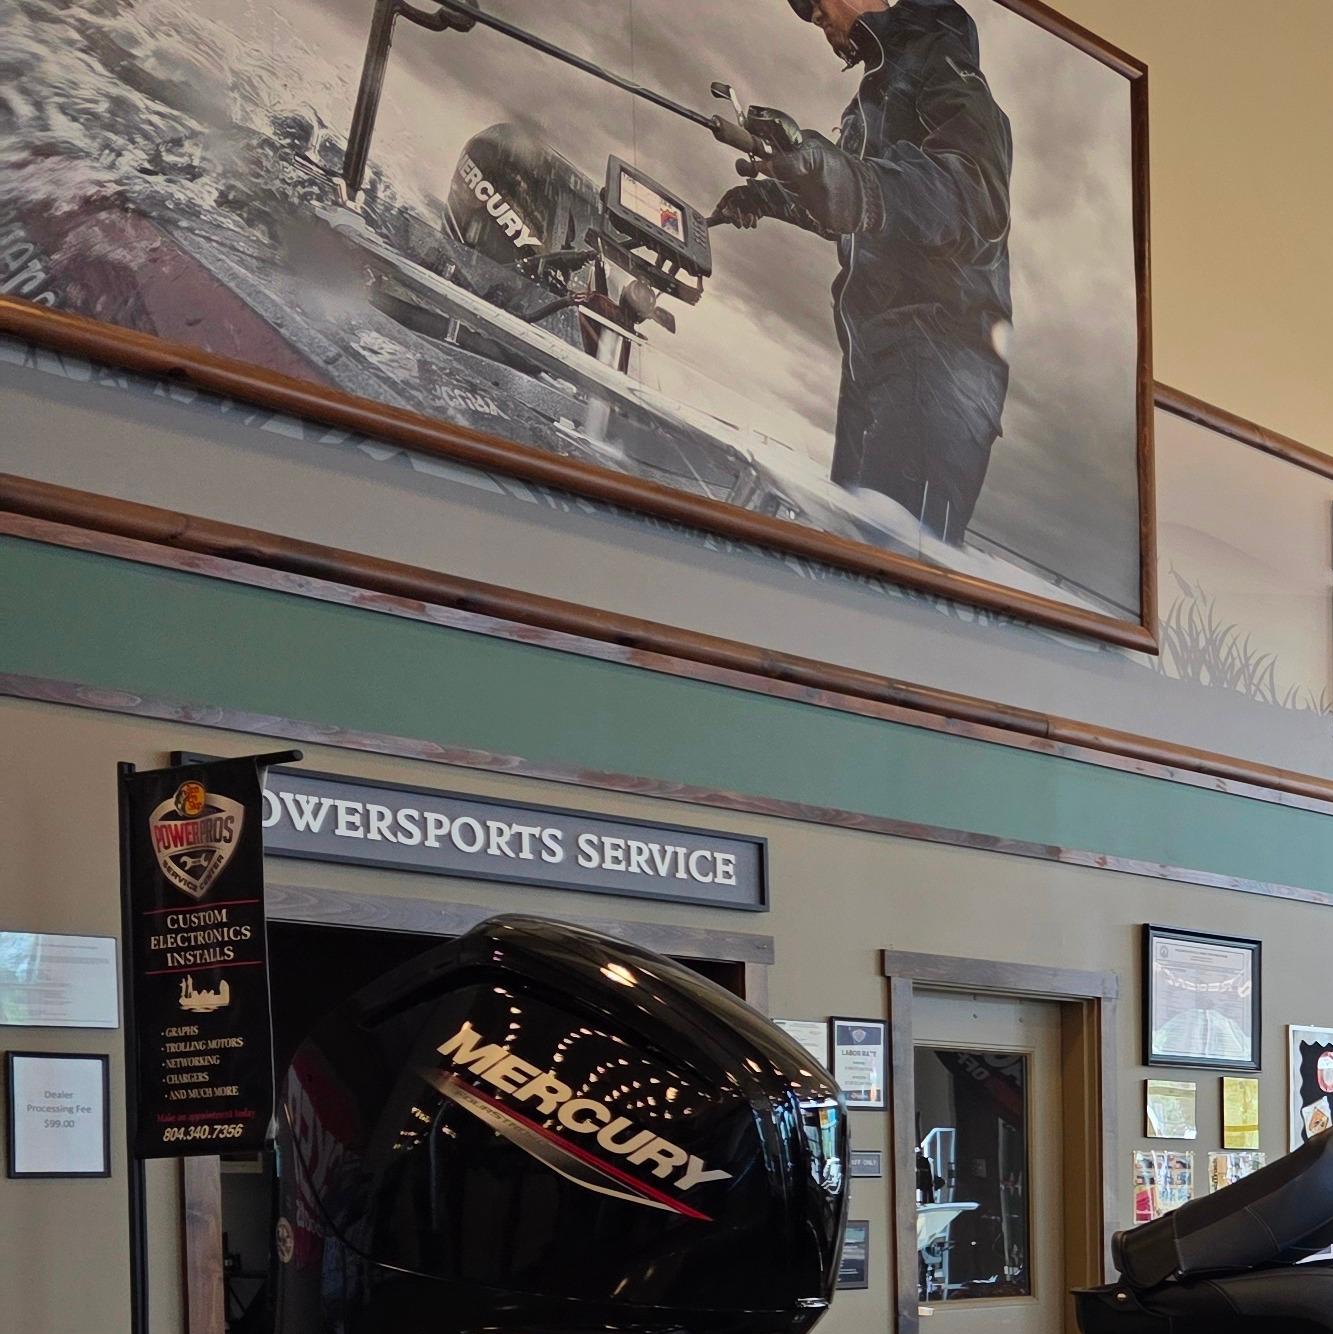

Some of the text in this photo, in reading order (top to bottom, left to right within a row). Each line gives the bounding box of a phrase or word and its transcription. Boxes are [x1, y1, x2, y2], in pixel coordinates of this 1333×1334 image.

[577, 832, 737, 886] SERVICE
[163, 859, 198, 892] SERVICE
[166, 909, 228, 929] CUSTOM
[151, 925, 252, 950] ELECTRONICS
[166, 946, 235, 967] INSTALLS
[165, 1025, 199, 1037] GRAPHS
[165, 1037, 244, 1053] TROLLING MOTORS
[166, 1055, 220, 1068] NETWORKING
[166, 1072, 210, 1084] CHARGERS
[44, 1090, 73, 1099] Dealer
[169, 1085, 239, 1100] AND MUCH MORE
[27, 1104, 92, 1115] Processing Fee
[436, 1022, 733, 1191] MERCURY
[44, 1118, 75, 1129] $99.00
[163, 1124, 244, 1141] 804.340.7356
